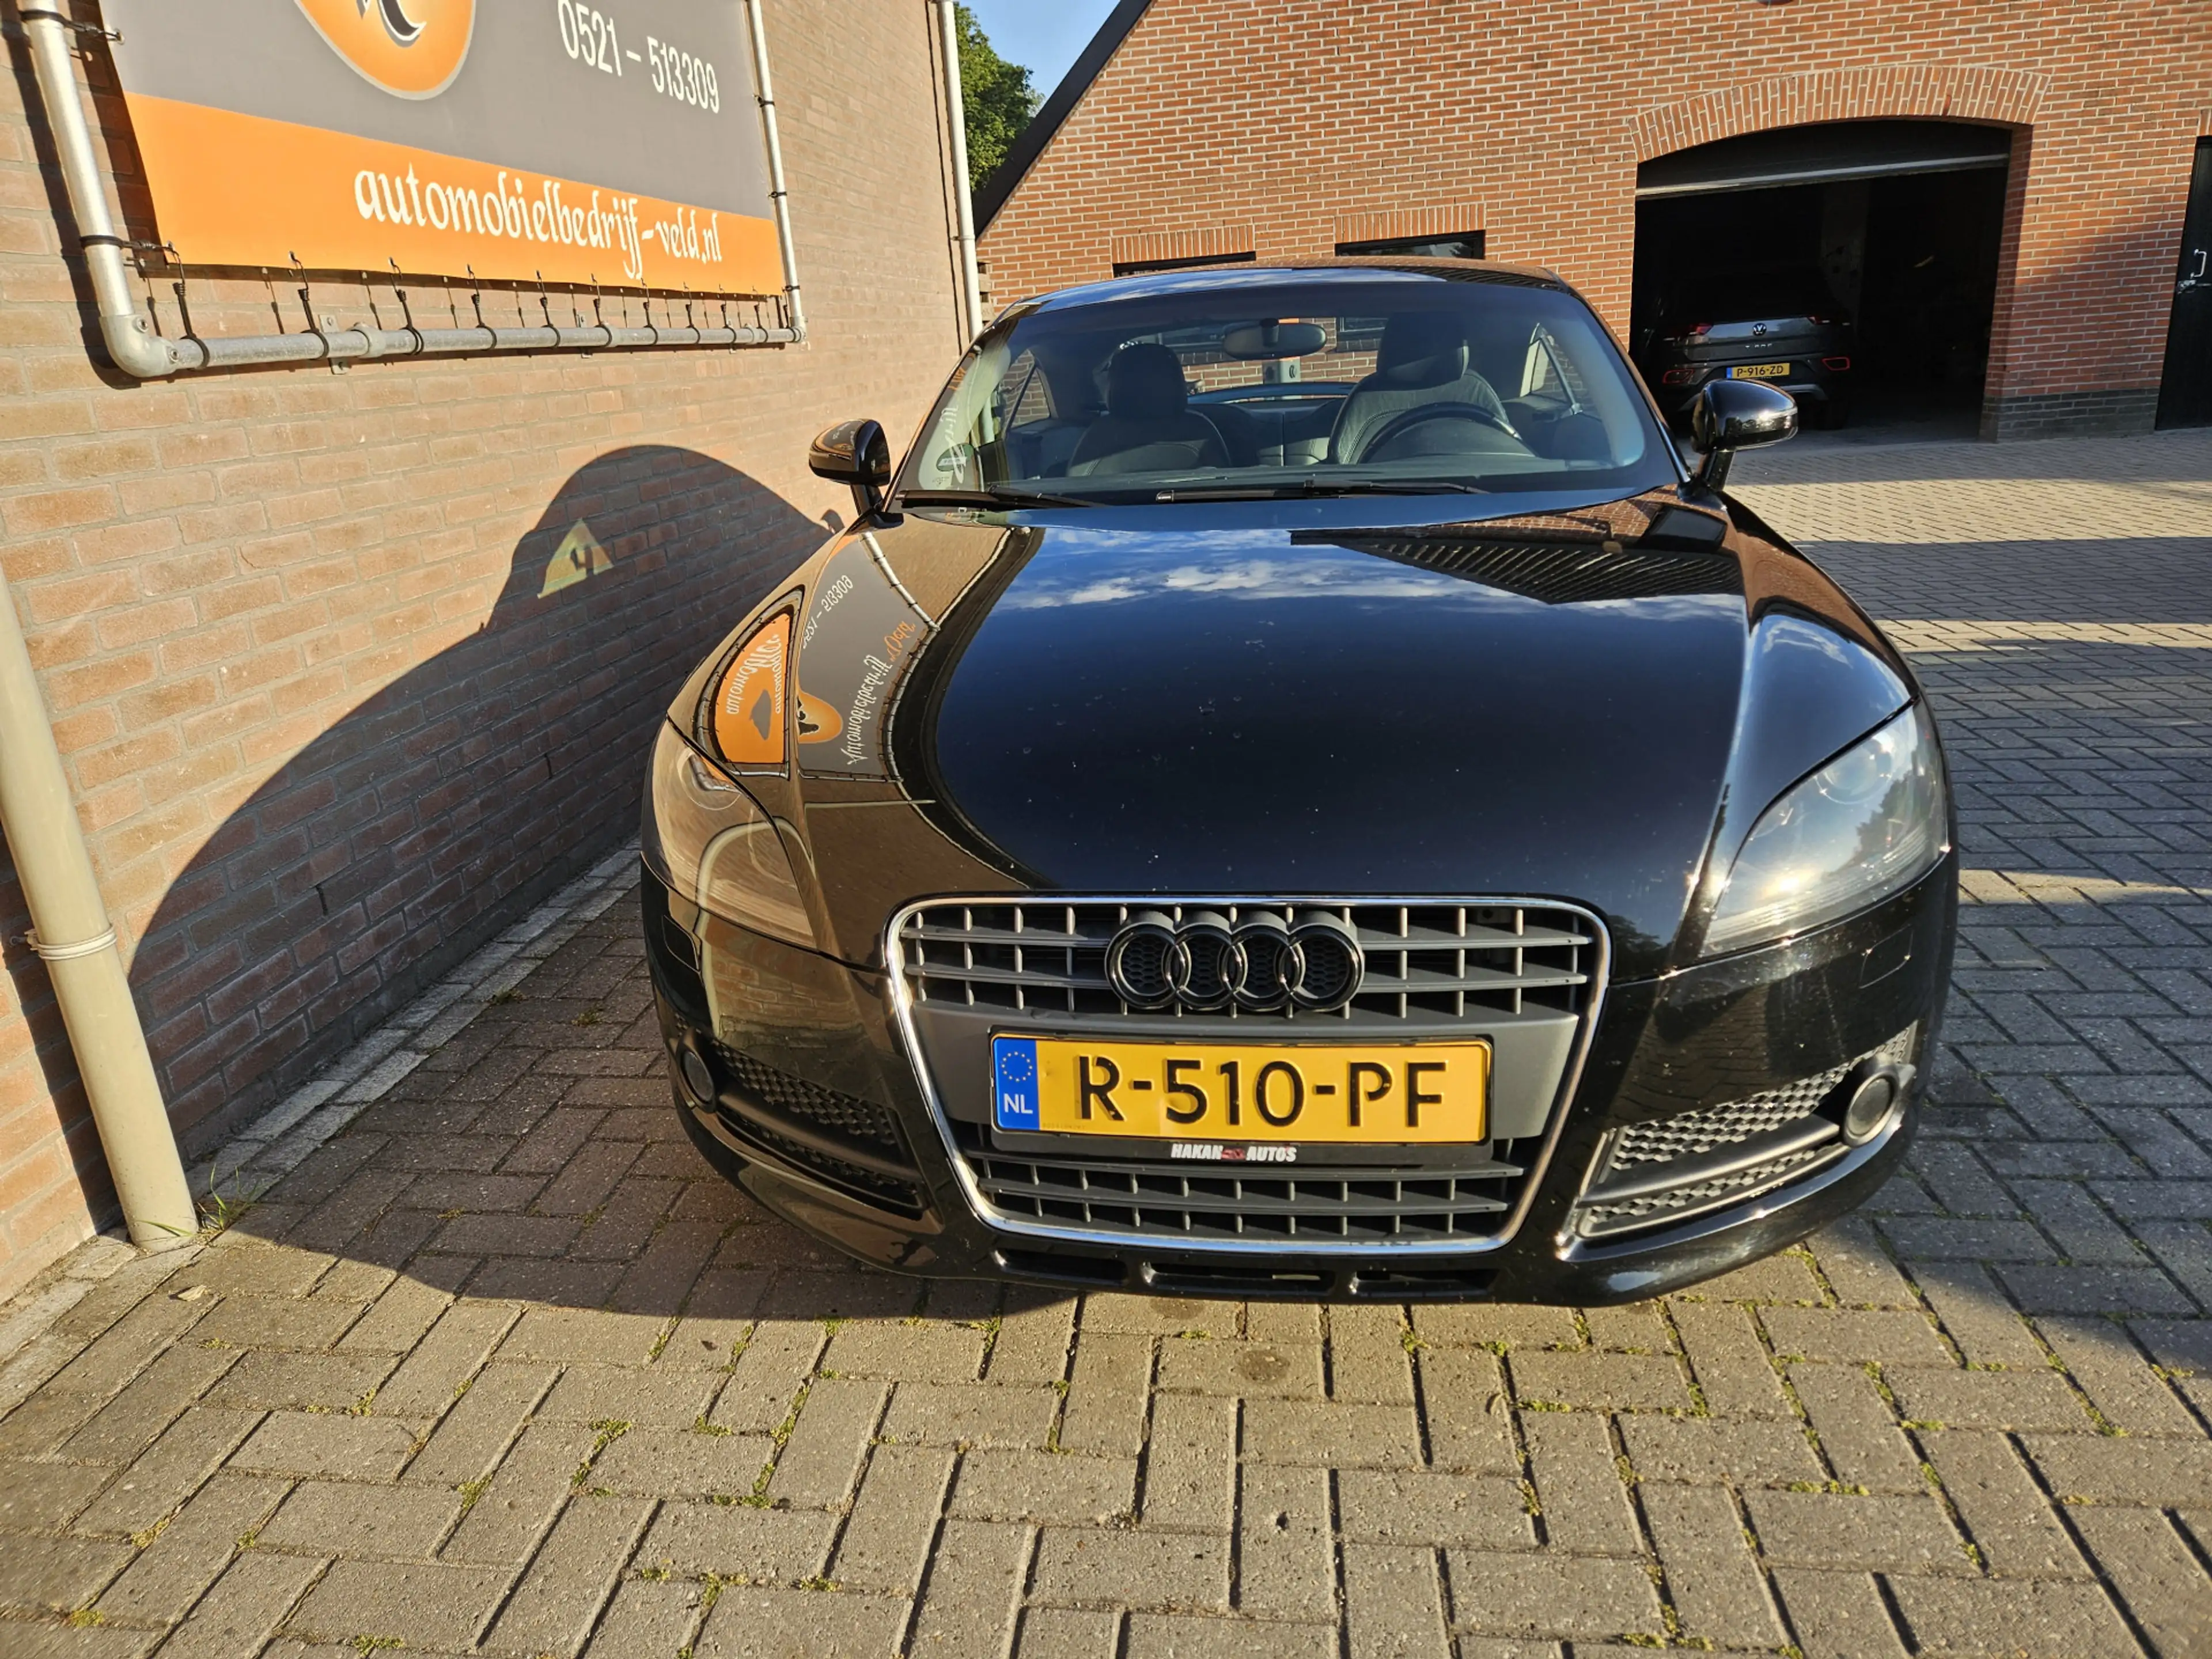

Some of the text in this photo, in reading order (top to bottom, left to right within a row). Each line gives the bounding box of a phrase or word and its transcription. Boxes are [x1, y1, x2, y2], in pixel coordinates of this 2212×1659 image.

[557, 0, 622, 77] 0521
[647, 36, 720, 113] 513309
[354, 162, 723, 280] automobielbedrijf-veld.nl
[1737, 365, 1784, 377] P-916-ZD
[1003, 1092, 1033, 1115] NL
[1078, 1054, 1447, 1129] R-510-PF
[1171, 1143, 1297, 1162] HAKAN AUTOS
